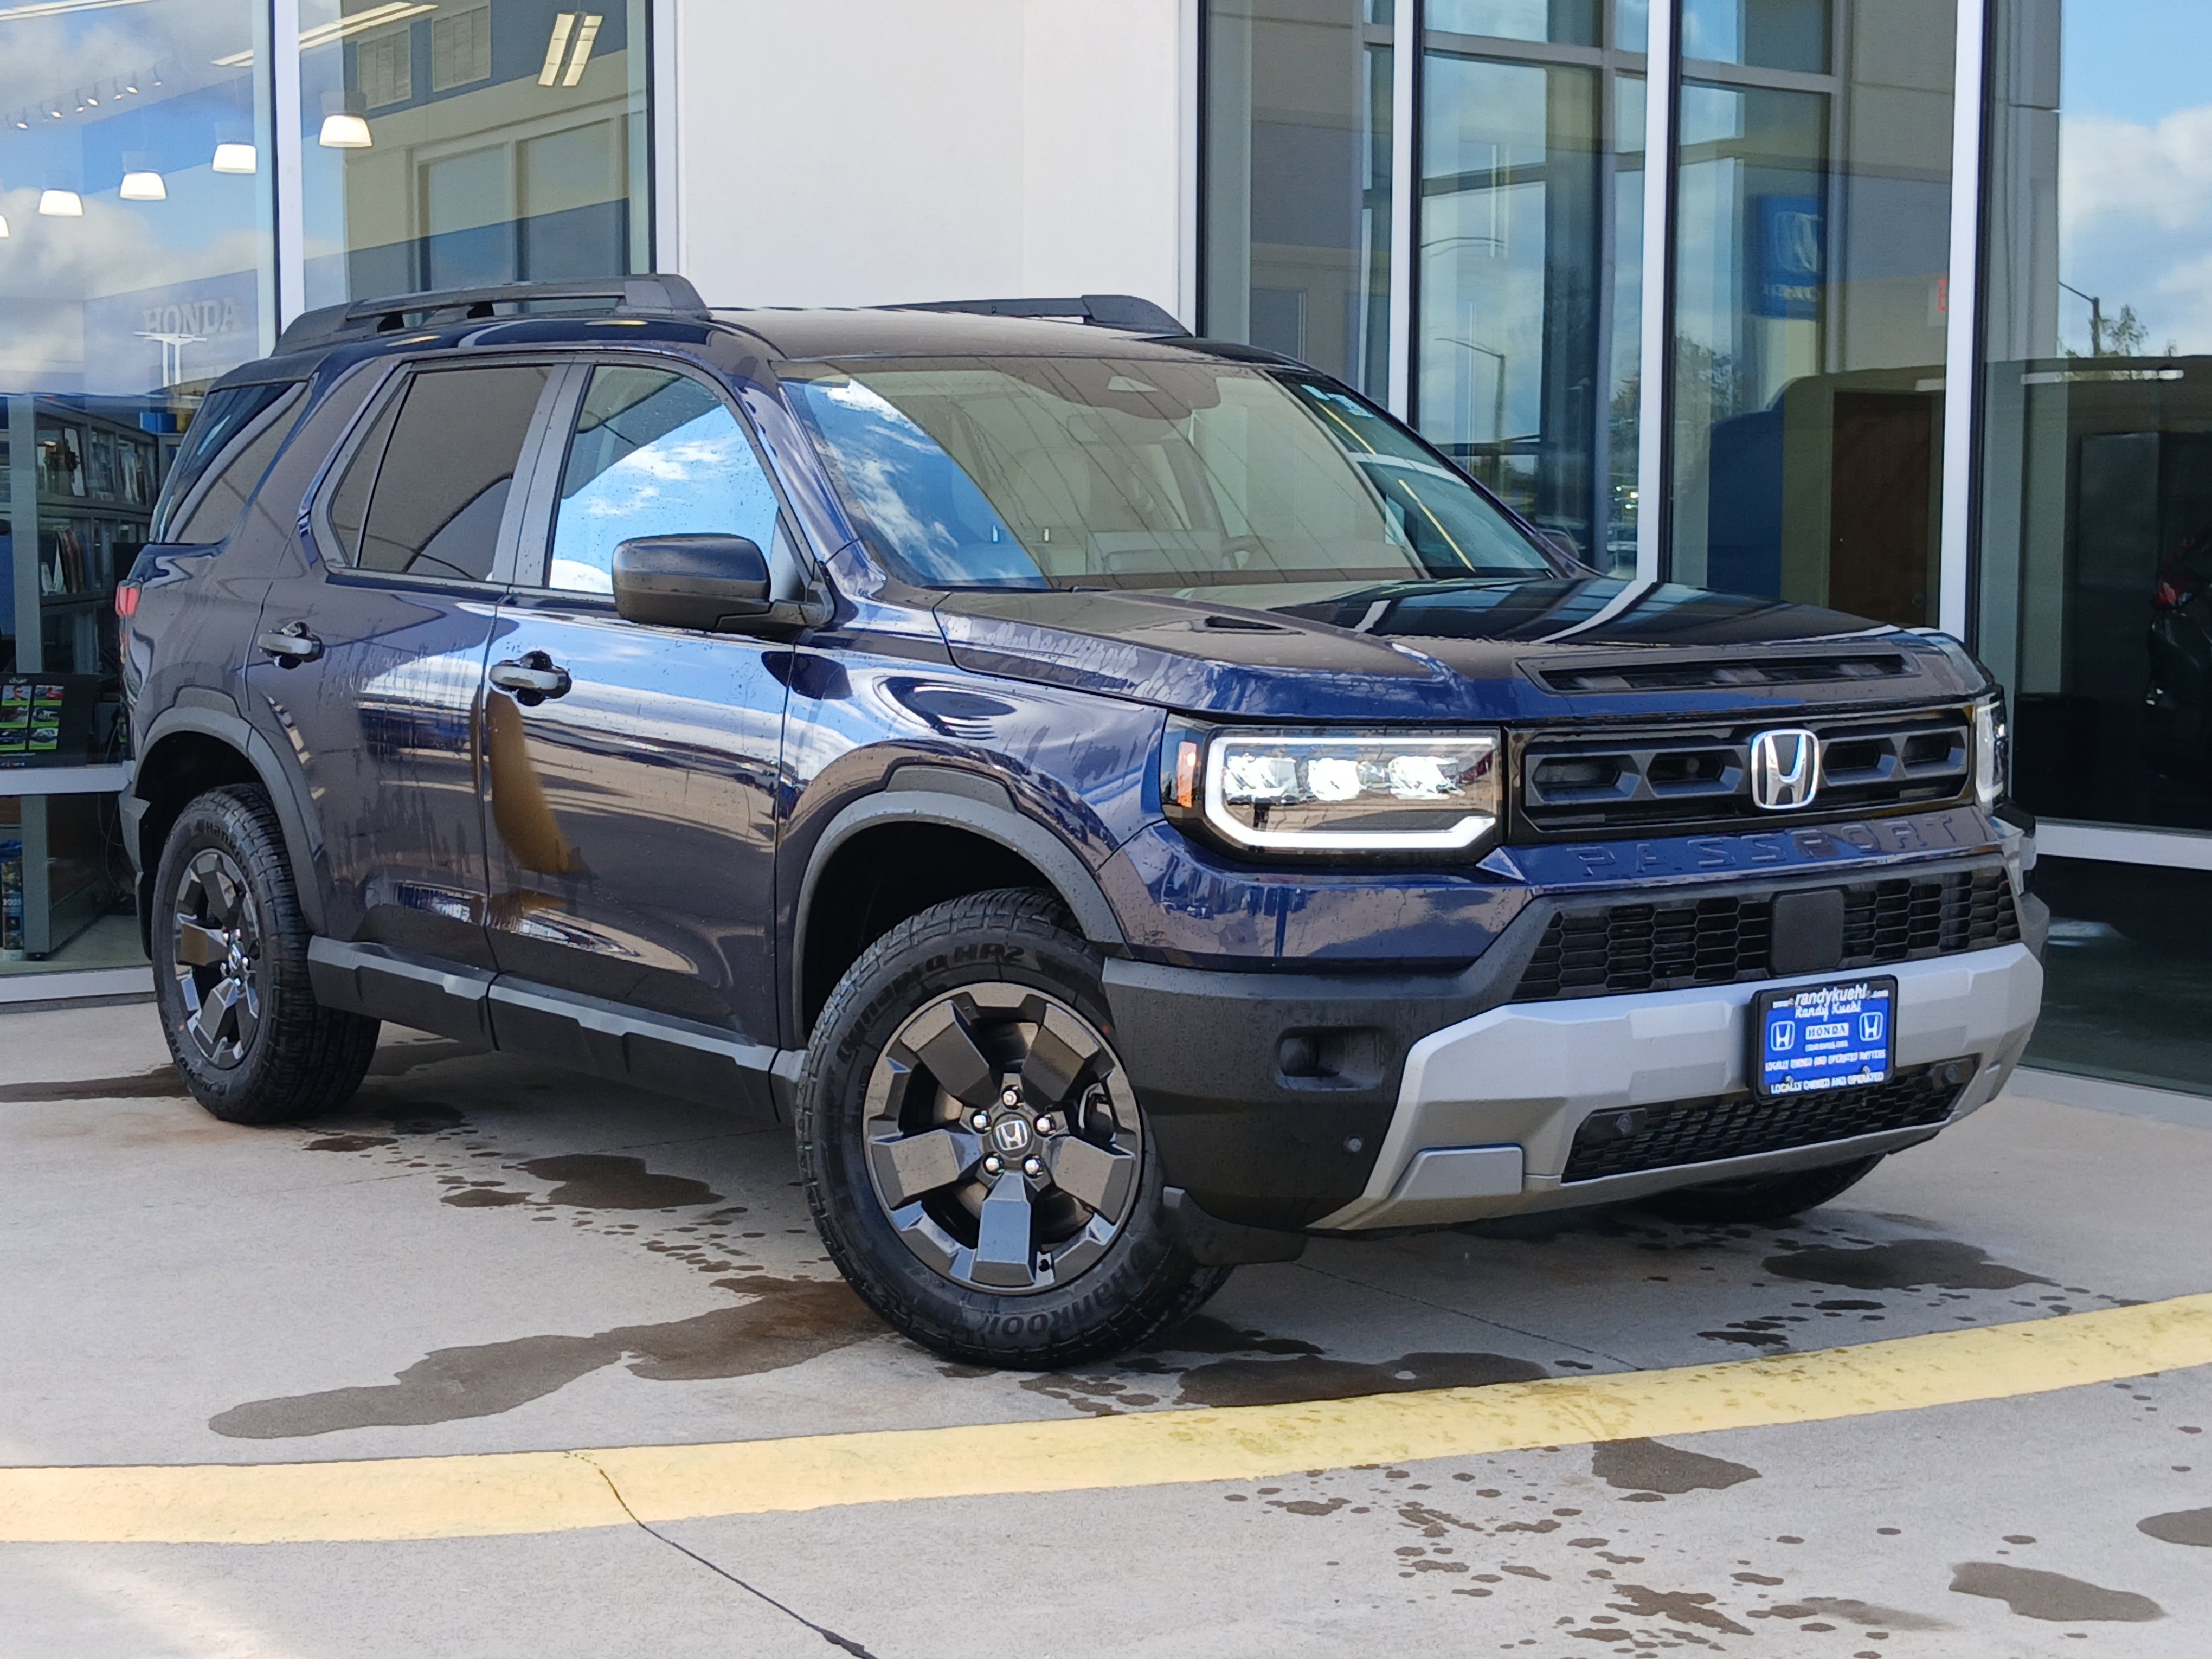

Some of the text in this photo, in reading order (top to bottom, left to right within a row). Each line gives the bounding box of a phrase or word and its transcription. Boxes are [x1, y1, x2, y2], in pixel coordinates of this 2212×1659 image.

[144, 297, 239, 335] HONDA
[1566, 815, 1953, 877] PASSPORT
[1795, 1002, 1829, 1021] Randy
[1808, 1025, 1846, 1037] HONDA
